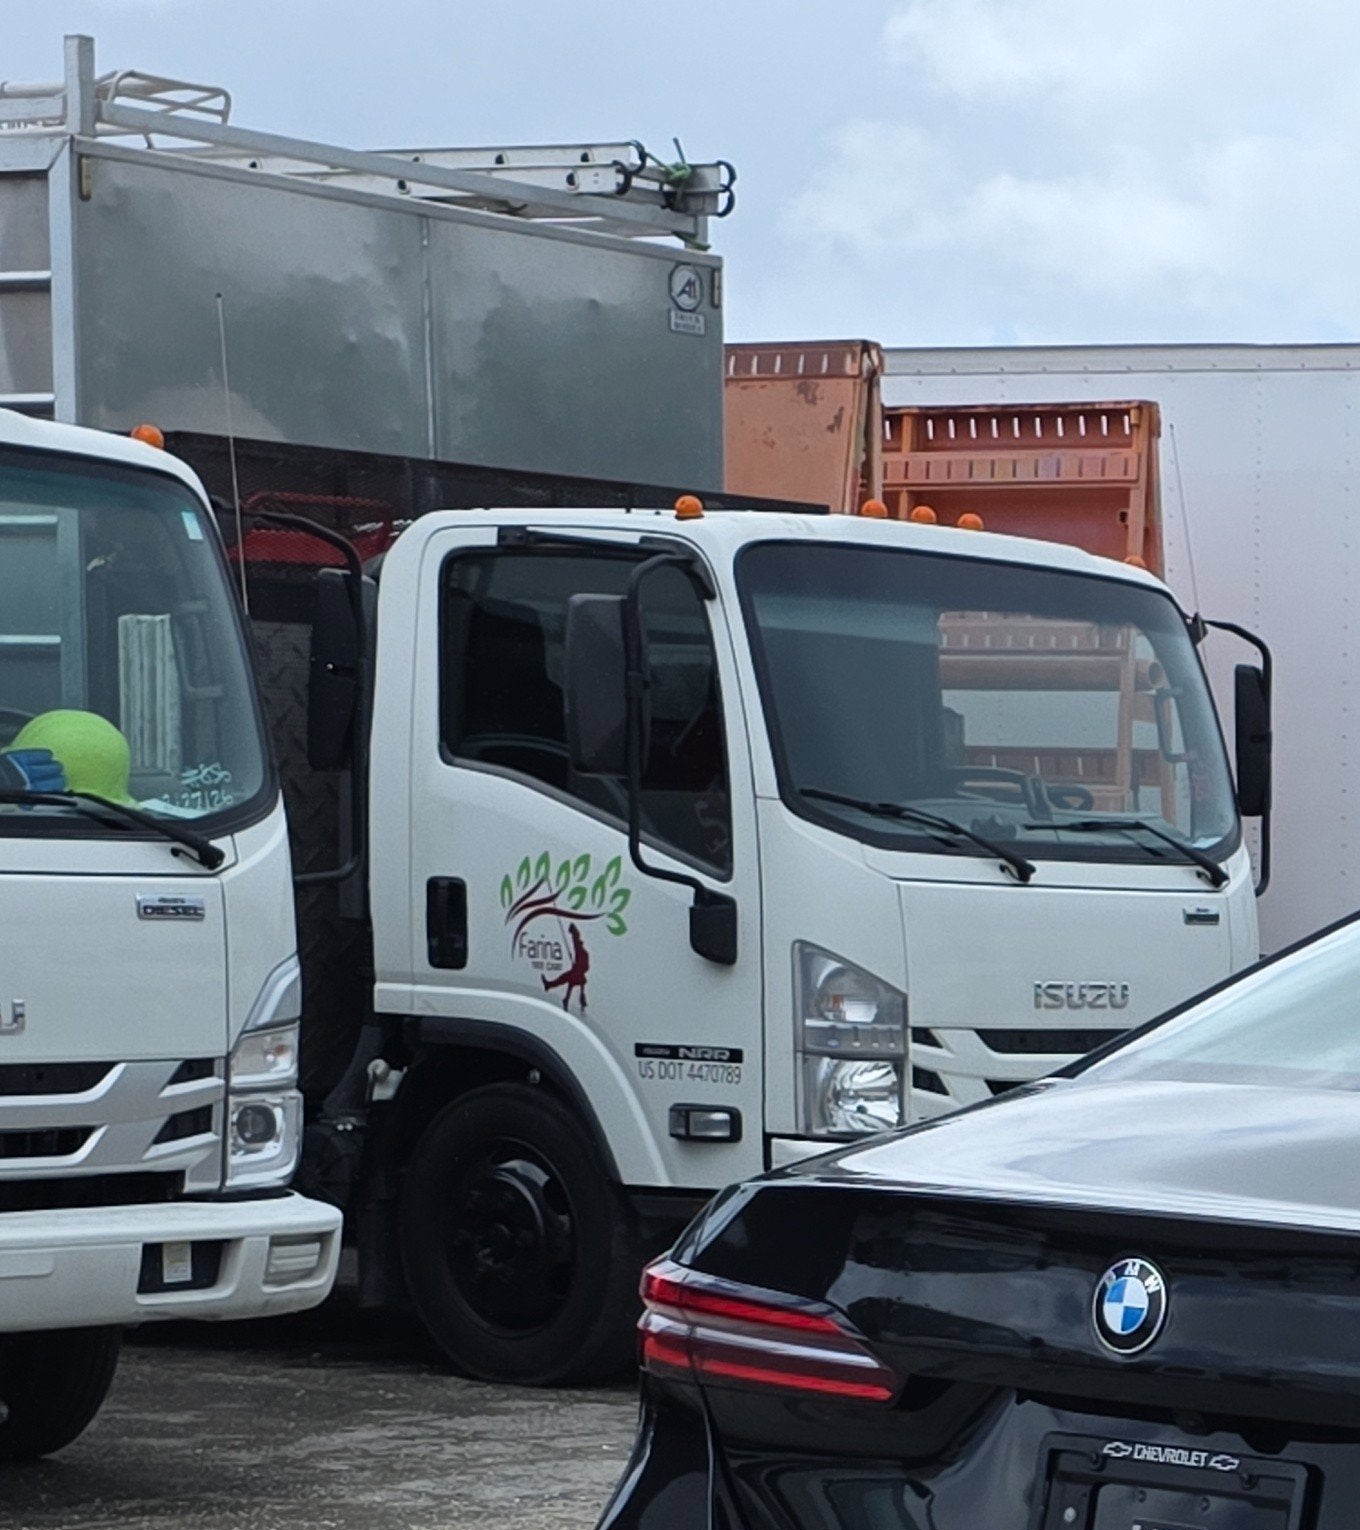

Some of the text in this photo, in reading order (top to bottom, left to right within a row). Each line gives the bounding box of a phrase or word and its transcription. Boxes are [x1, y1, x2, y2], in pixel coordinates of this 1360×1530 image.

[1034, 981, 1129, 1009] ISUZU
[638, 1061, 654, 1079] US
[658, 1061, 684, 1080] DOT
[1133, 1443, 1209, 1468] CHEVROLET
